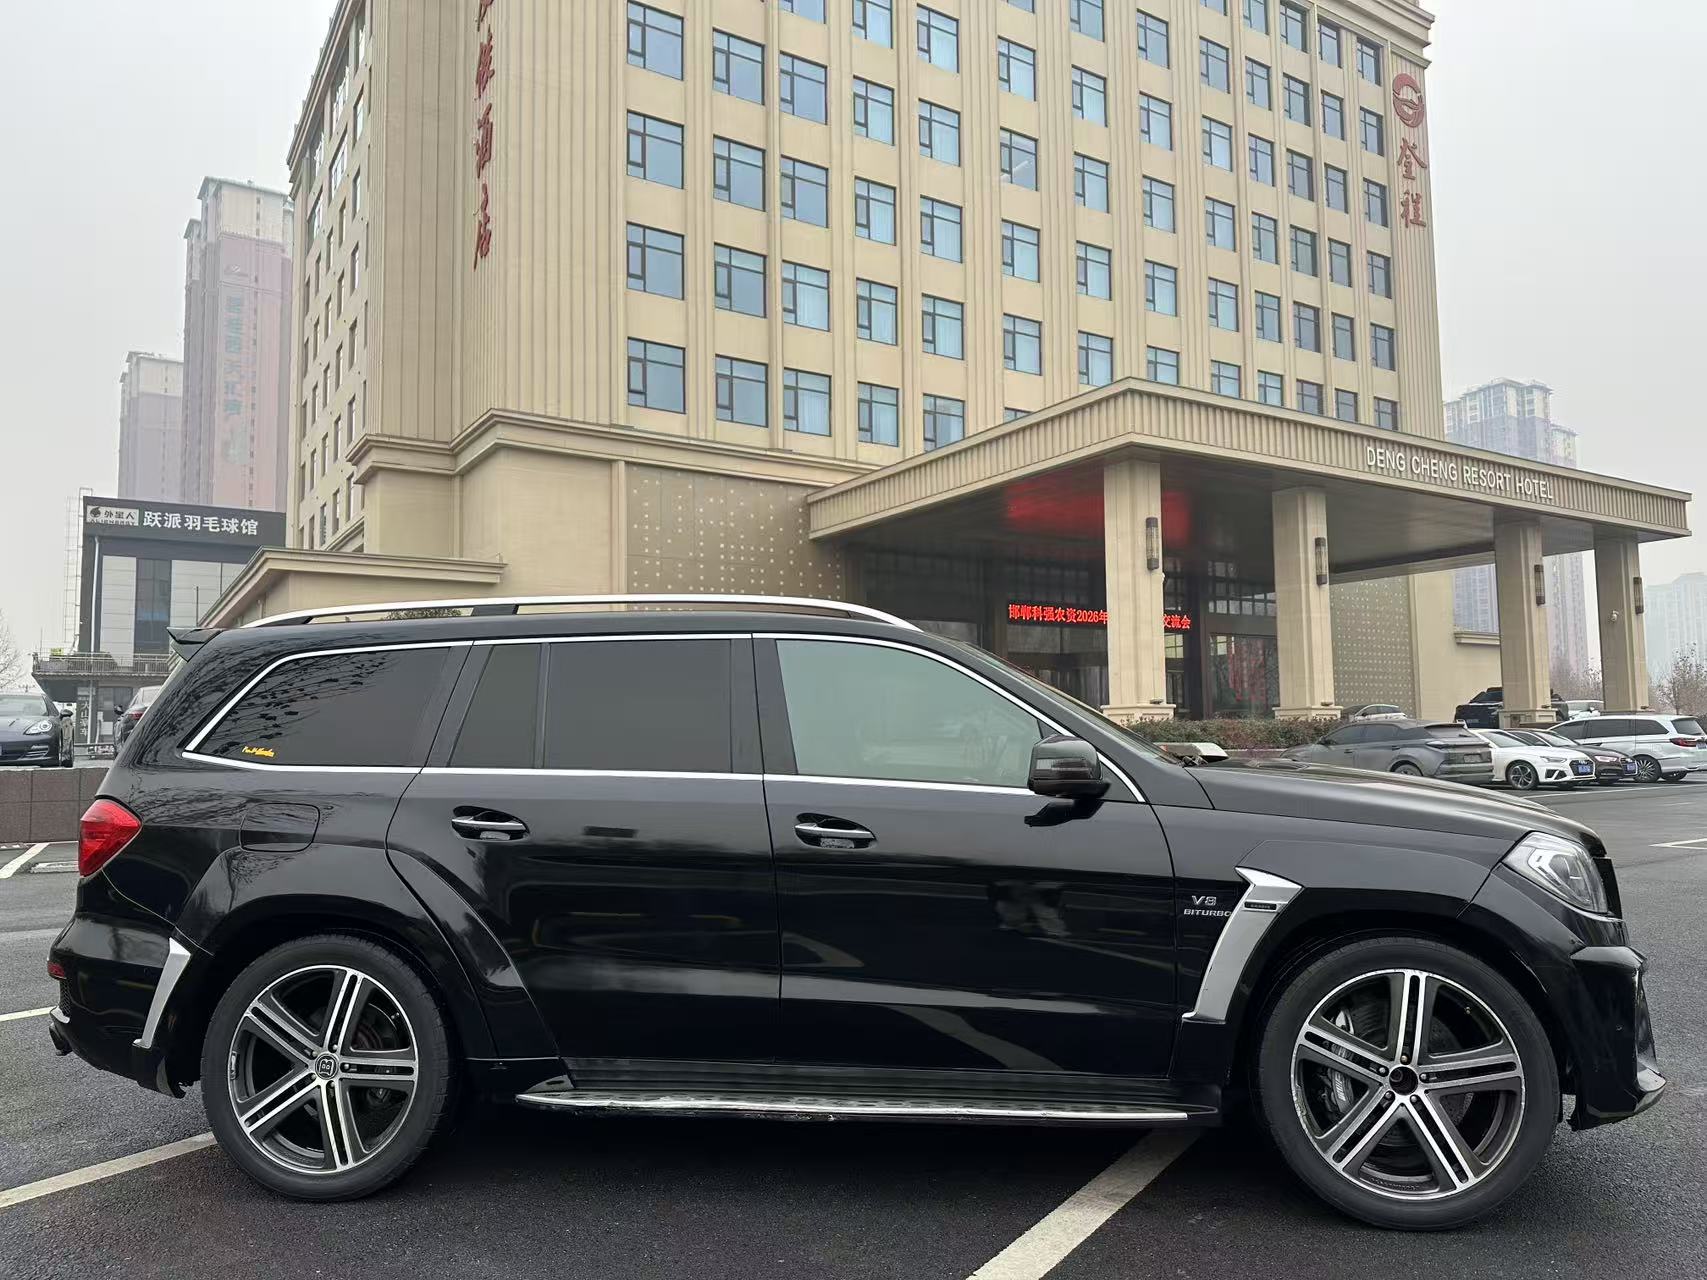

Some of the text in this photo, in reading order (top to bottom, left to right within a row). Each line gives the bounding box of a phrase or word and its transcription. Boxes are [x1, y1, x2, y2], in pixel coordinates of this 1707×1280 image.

[1366, 446, 1554, 499] DENG CHENG RESORT HOTEL
[142, 511, 259, 536] 跃派羽毛球馆
[1191, 895, 1217, 906] V8
[1183, 908, 1232, 917] BITURBO
